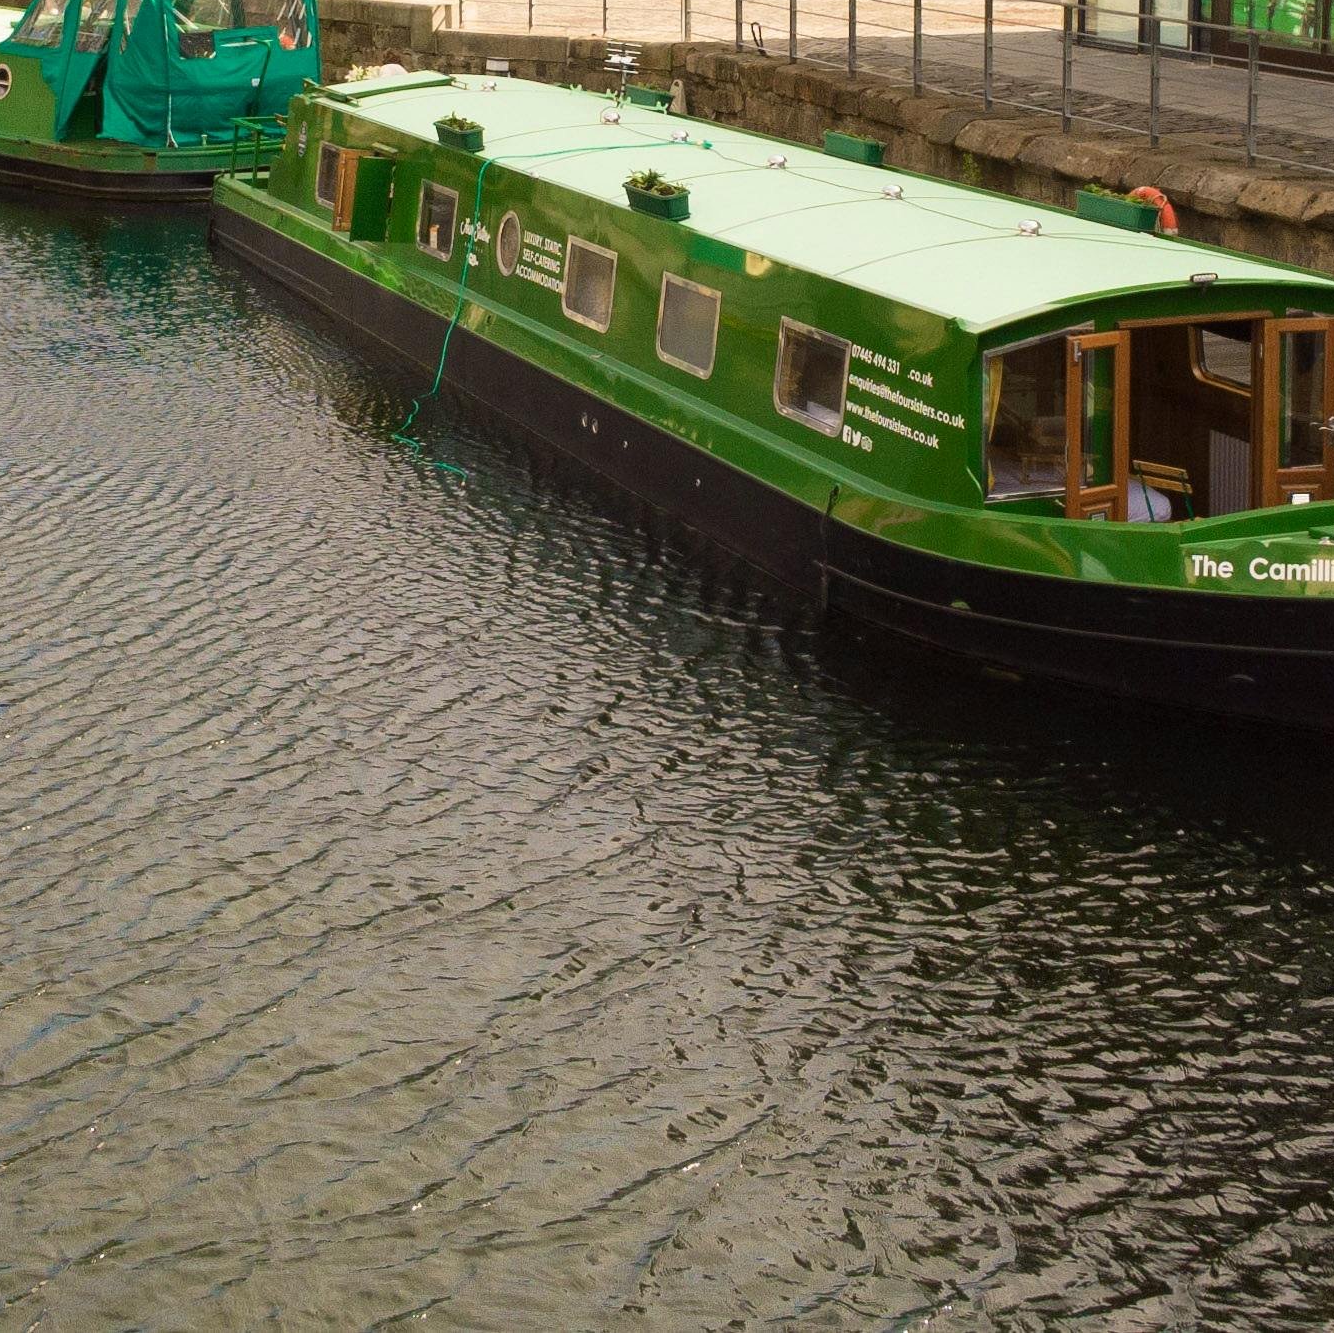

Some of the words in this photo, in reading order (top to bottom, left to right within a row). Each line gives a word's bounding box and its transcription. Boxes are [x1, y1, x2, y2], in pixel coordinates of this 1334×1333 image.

[851, 344, 874, 365] 07445
[873, 352, 887, 371] 494
[886, 358, 901, 376] 331
[1191, 554, 1234, 579] The
